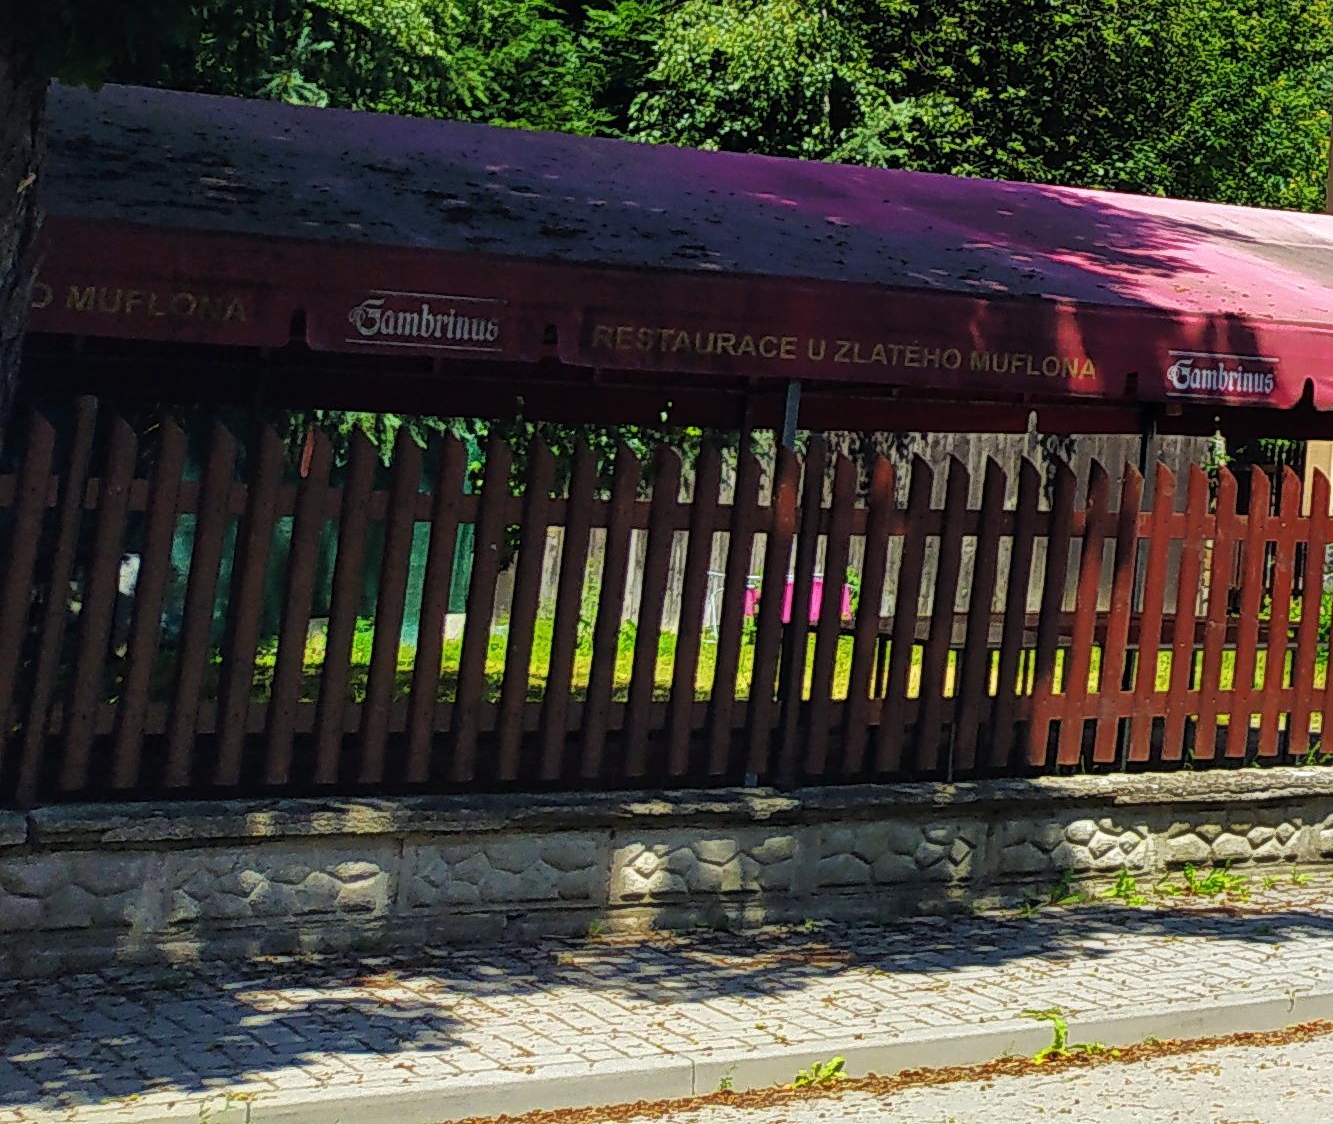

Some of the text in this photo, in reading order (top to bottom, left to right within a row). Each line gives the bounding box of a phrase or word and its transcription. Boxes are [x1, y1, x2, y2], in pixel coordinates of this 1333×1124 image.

[348, 297, 500, 343] Gambrinus
[592, 324, 1098, 380] RESTAURACE U ZLATÉHO MUFLONA
[1166, 358, 1275, 395] Gambrinus
